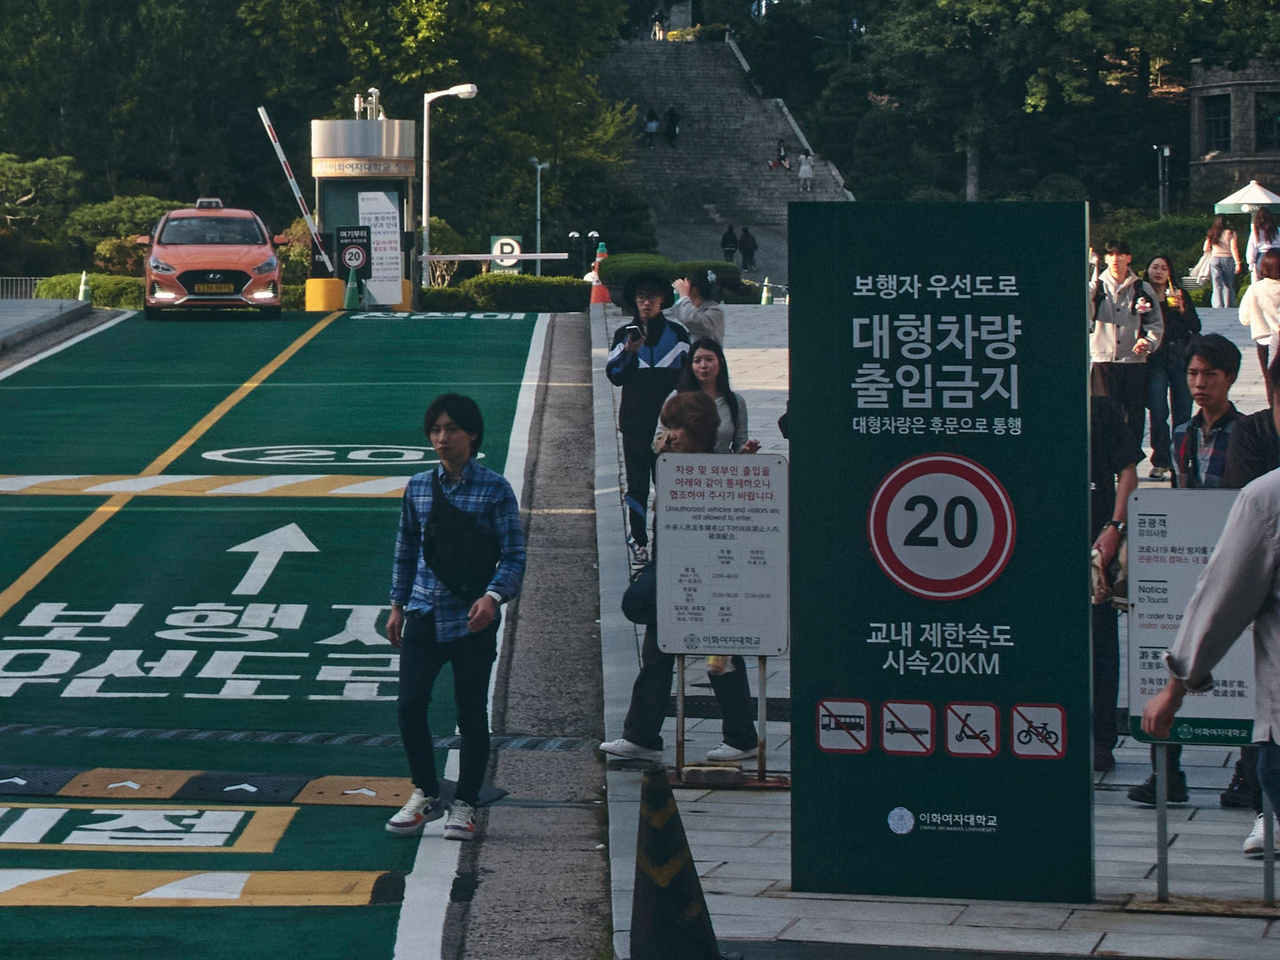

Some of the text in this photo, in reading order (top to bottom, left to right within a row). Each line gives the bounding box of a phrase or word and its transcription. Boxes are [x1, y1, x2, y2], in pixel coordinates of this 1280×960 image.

[339, 229, 367, 238] 여기부터
[348, 252, 361, 261] 20
[500, 243, 515, 262] P
[852, 274, 1019, 299] 보행자 우선도로
[852, 314, 1022, 359] 대형차량
[851, 363, 1018, 409] 출입금지
[852, 416, 1022, 435] 대형차량은 후문으로 통행
[256, 449, 425, 461] 20
[675, 465, 771, 477] 차량 및 외부인 출입을
[675, 478, 702, 488] 아래와
[726, 478, 771, 489] 통제하오니
[669, 490, 705, 500] 협조하여
[708, 490, 735, 500] 주시기
[665, 505, 705, 513] Unauthorized
[707, 506, 732, 514] vehicles
[747, 507, 768, 515] visitors
[903, 495, 978, 548] 20
[1138, 518, 1167, 528] 관광객
[1138, 529, 1167, 538] 유의사항
[1138, 545, 1168, 554] 코로나19
[1170, 545, 1184, 555] 확산
[1186, 546, 1208, 555] 방지를
[1138, 555, 1166, 564] 관광객의
[1138, 585, 1168, 594] Notice
[1147, 596, 1168, 604] Tourist
[866, 622, 1014, 648] 교내 제한속도
[702, 636, 761, 645] 이화여자대학교
[882, 650, 1000, 675] 시속20KM
[1194, 728, 1248, 737] 이화여자대학교
[919, 813, 998, 826] 이화여자대학교
